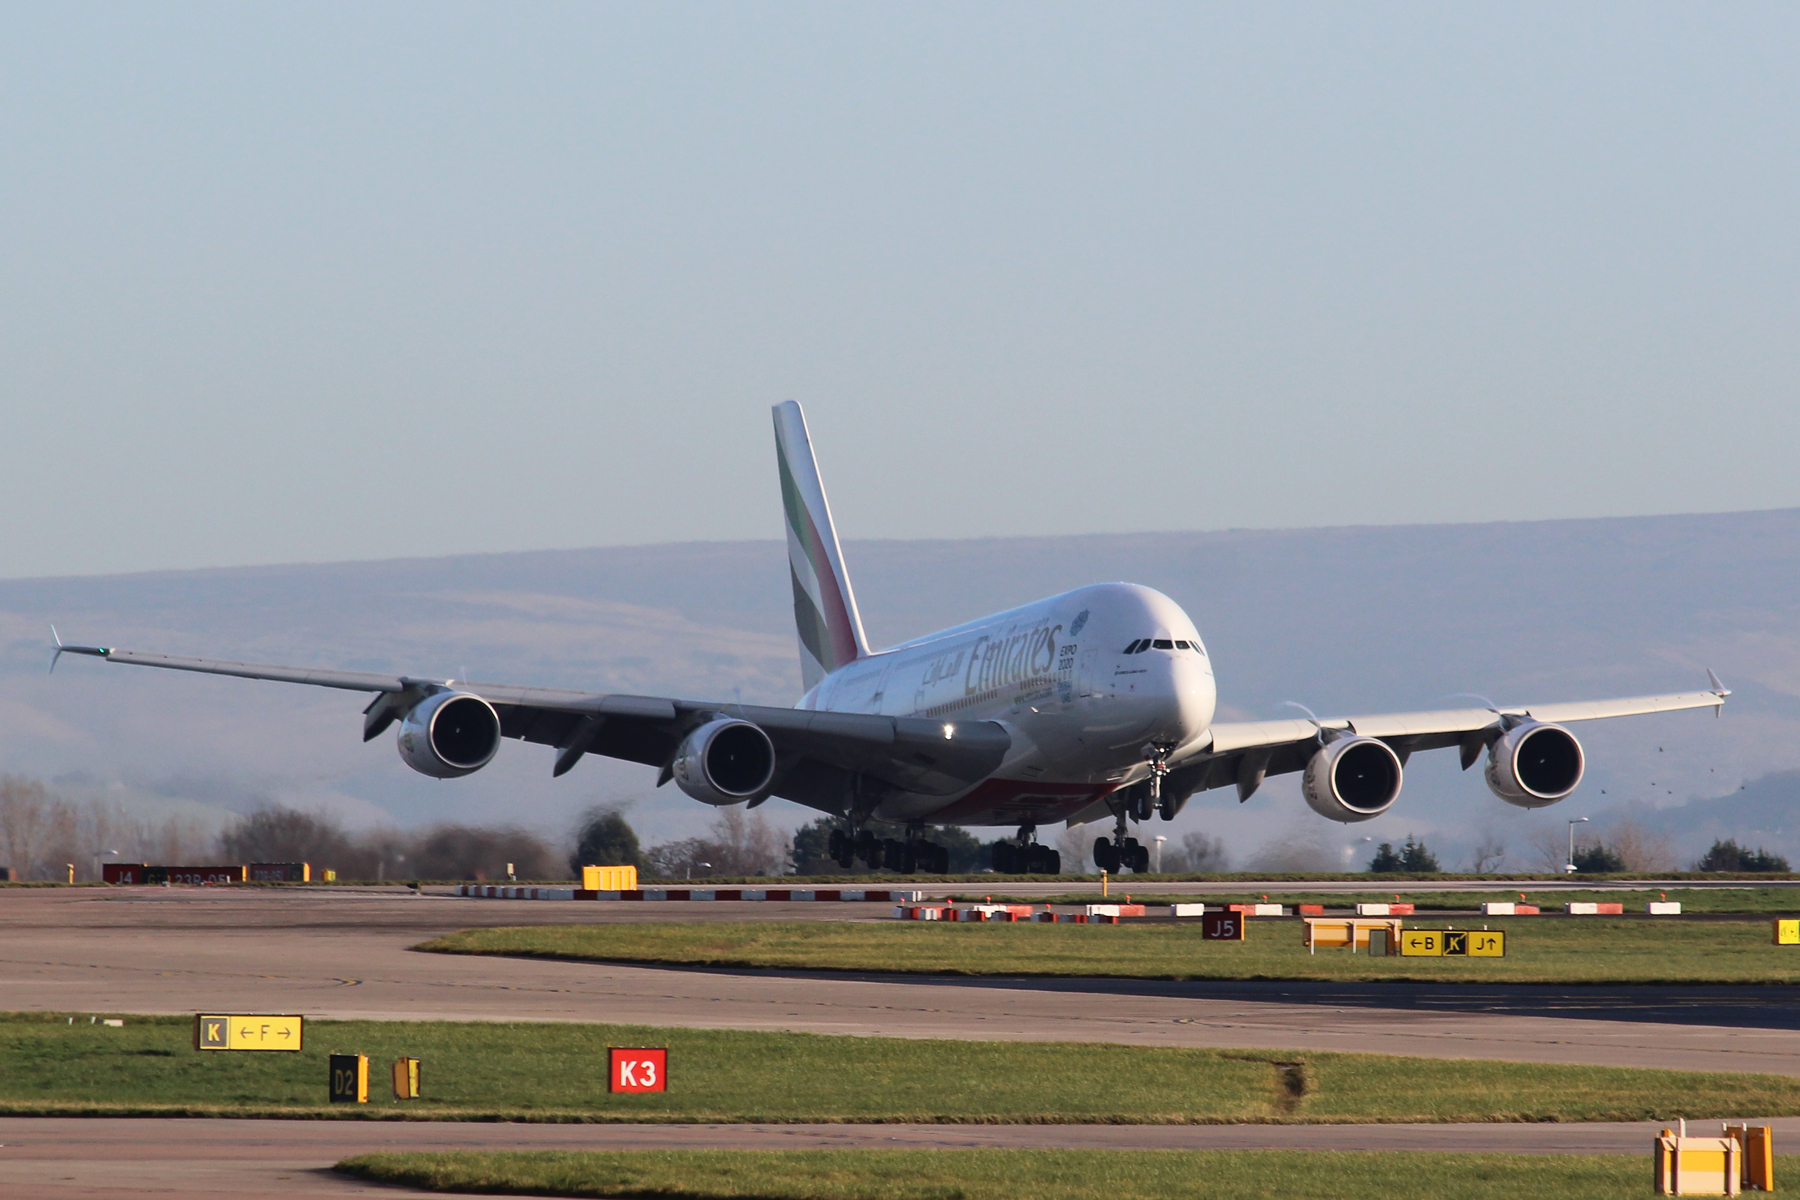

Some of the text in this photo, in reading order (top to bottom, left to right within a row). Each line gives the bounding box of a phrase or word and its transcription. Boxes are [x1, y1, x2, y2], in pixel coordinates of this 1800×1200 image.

[1060, 644, 1077, 656] EXPO
[965, 624, 1063, 694] Emirates
[1058, 657, 1073, 670] 2020
[116, 871, 132, 884] J4
[175, 874, 230, 884] 23R-05
[1211, 921, 1234, 937] J5
[1425, 937, 1485, 951] B K J
[208, 1023, 270, 1041] K F
[620, 1060, 657, 1087] K3
[335, 1070, 353, 1095] D2
